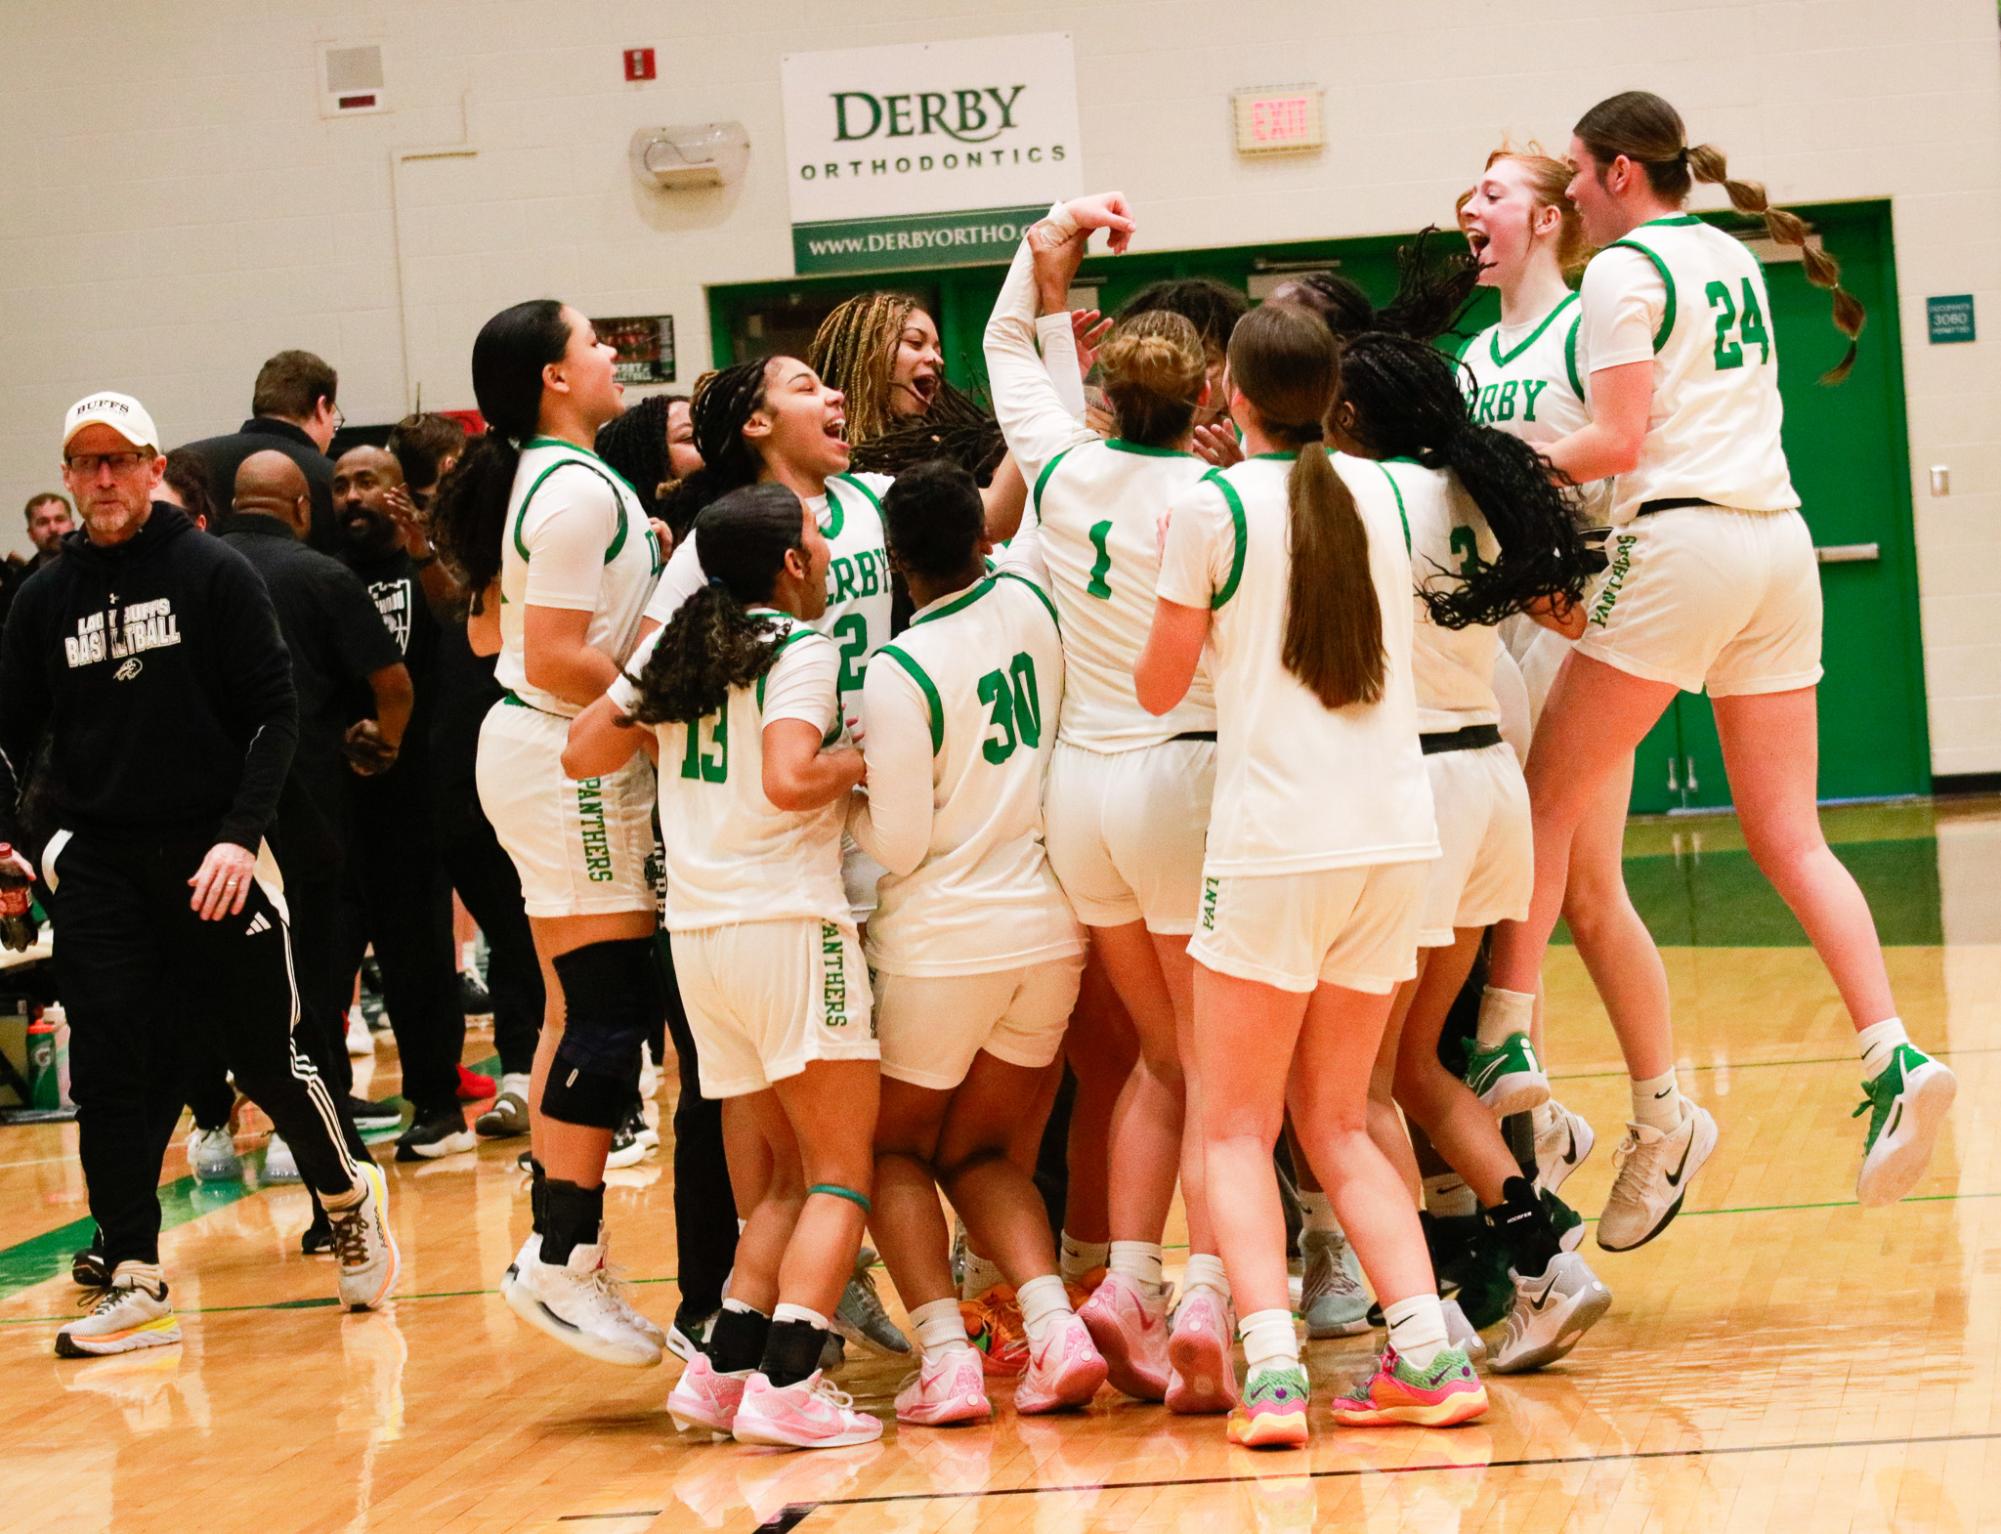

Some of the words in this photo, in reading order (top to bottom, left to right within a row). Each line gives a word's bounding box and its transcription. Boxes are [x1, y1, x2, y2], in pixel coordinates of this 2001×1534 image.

[830, 85, 1026, 143] DERBY
[1252, 99, 1306, 140] EXIT
[801, 145, 1066, 180] ORTHODONTICS
[1705, 277, 1770, 371] 24
[1087, 520, 1113, 600] 1
[833, 613, 868, 691] 2
[681, 704, 729, 784] 13
[977, 651, 1042, 766] 30
[577, 777, 613, 882] PANTHERS
[822, 919, 848, 1027] ANTHERS
